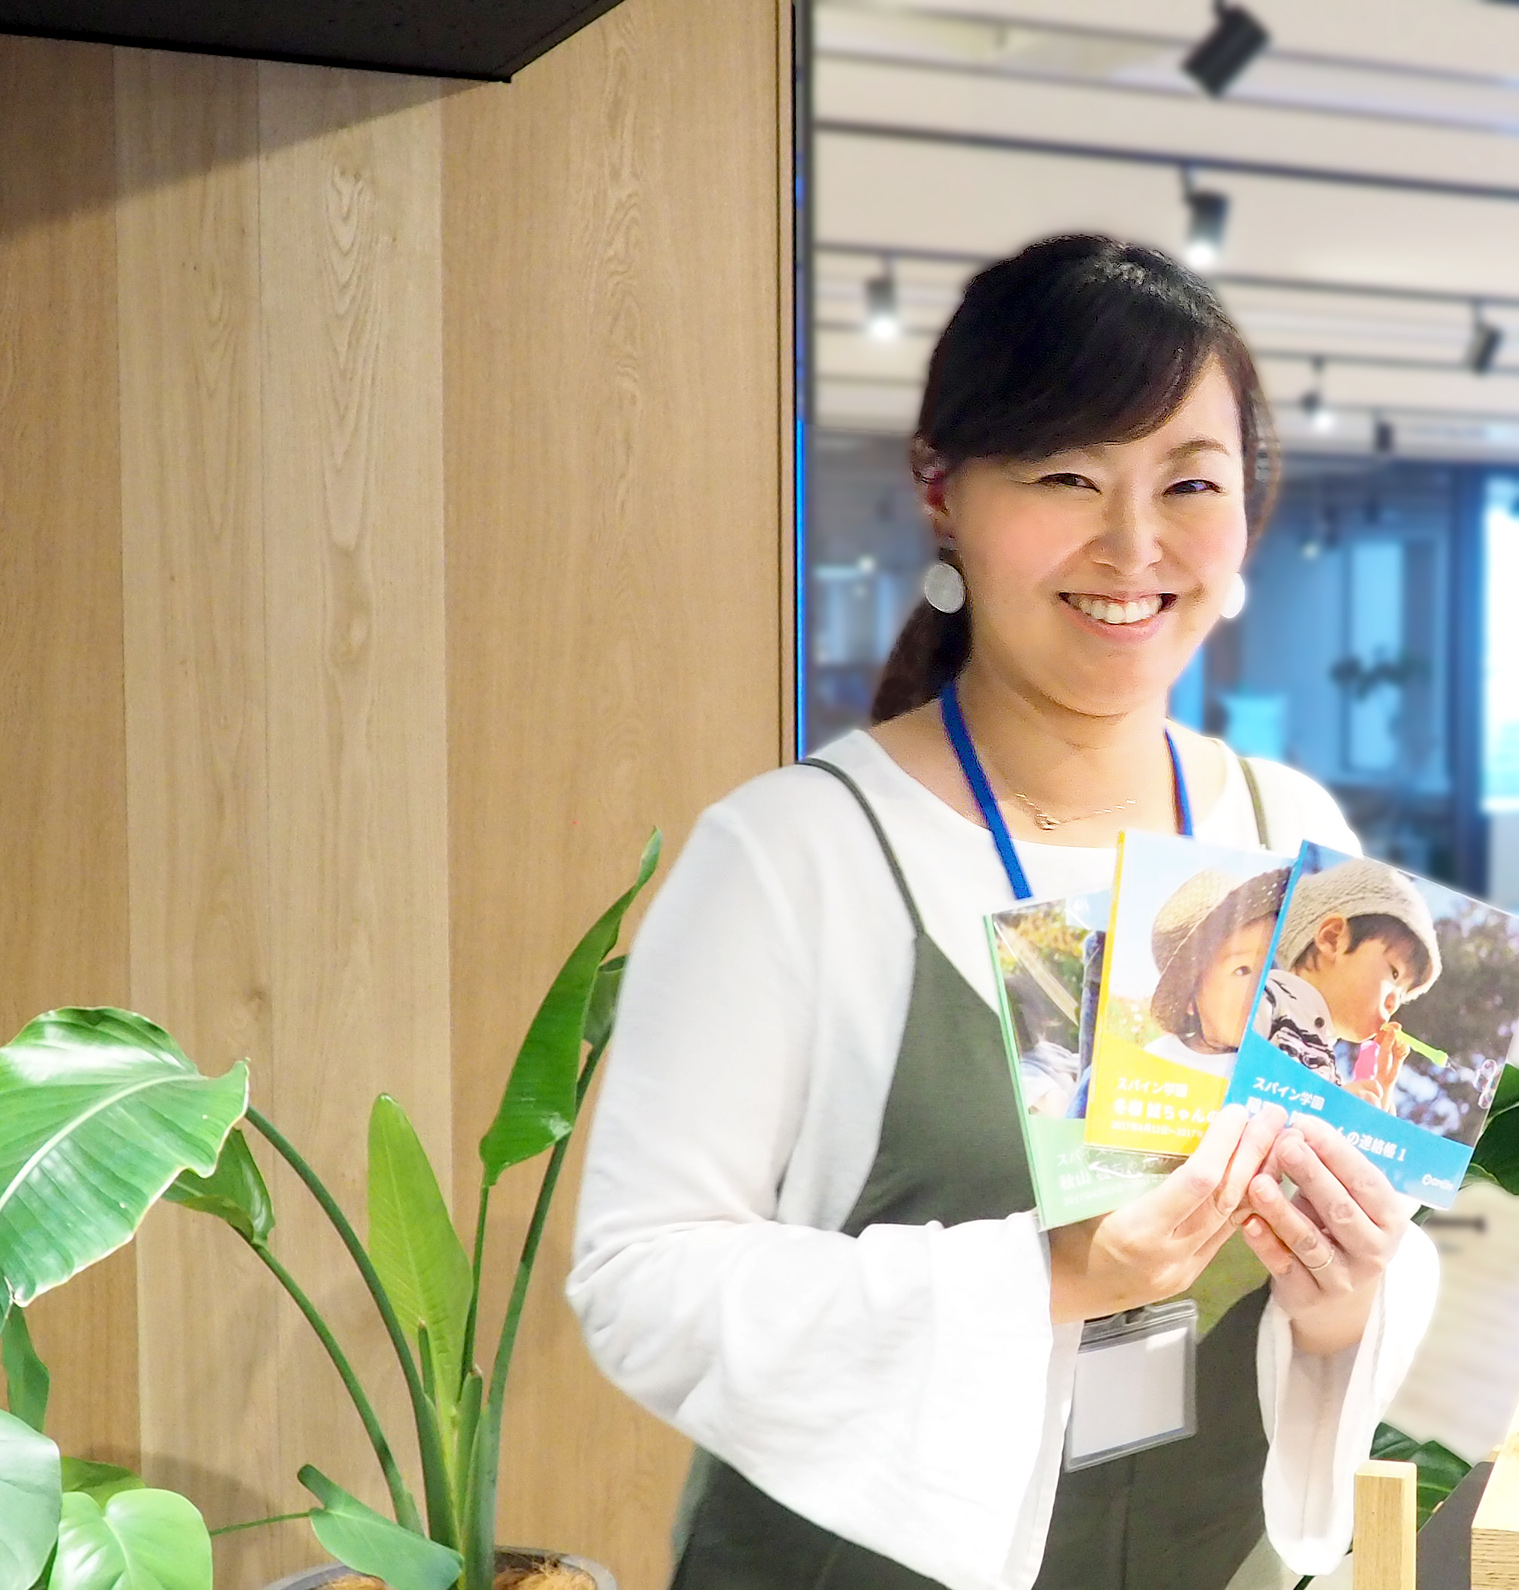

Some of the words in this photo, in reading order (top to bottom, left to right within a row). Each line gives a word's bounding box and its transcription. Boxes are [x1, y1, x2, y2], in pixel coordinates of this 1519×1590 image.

[1253, 1077, 1325, 1111] スパイン学園
